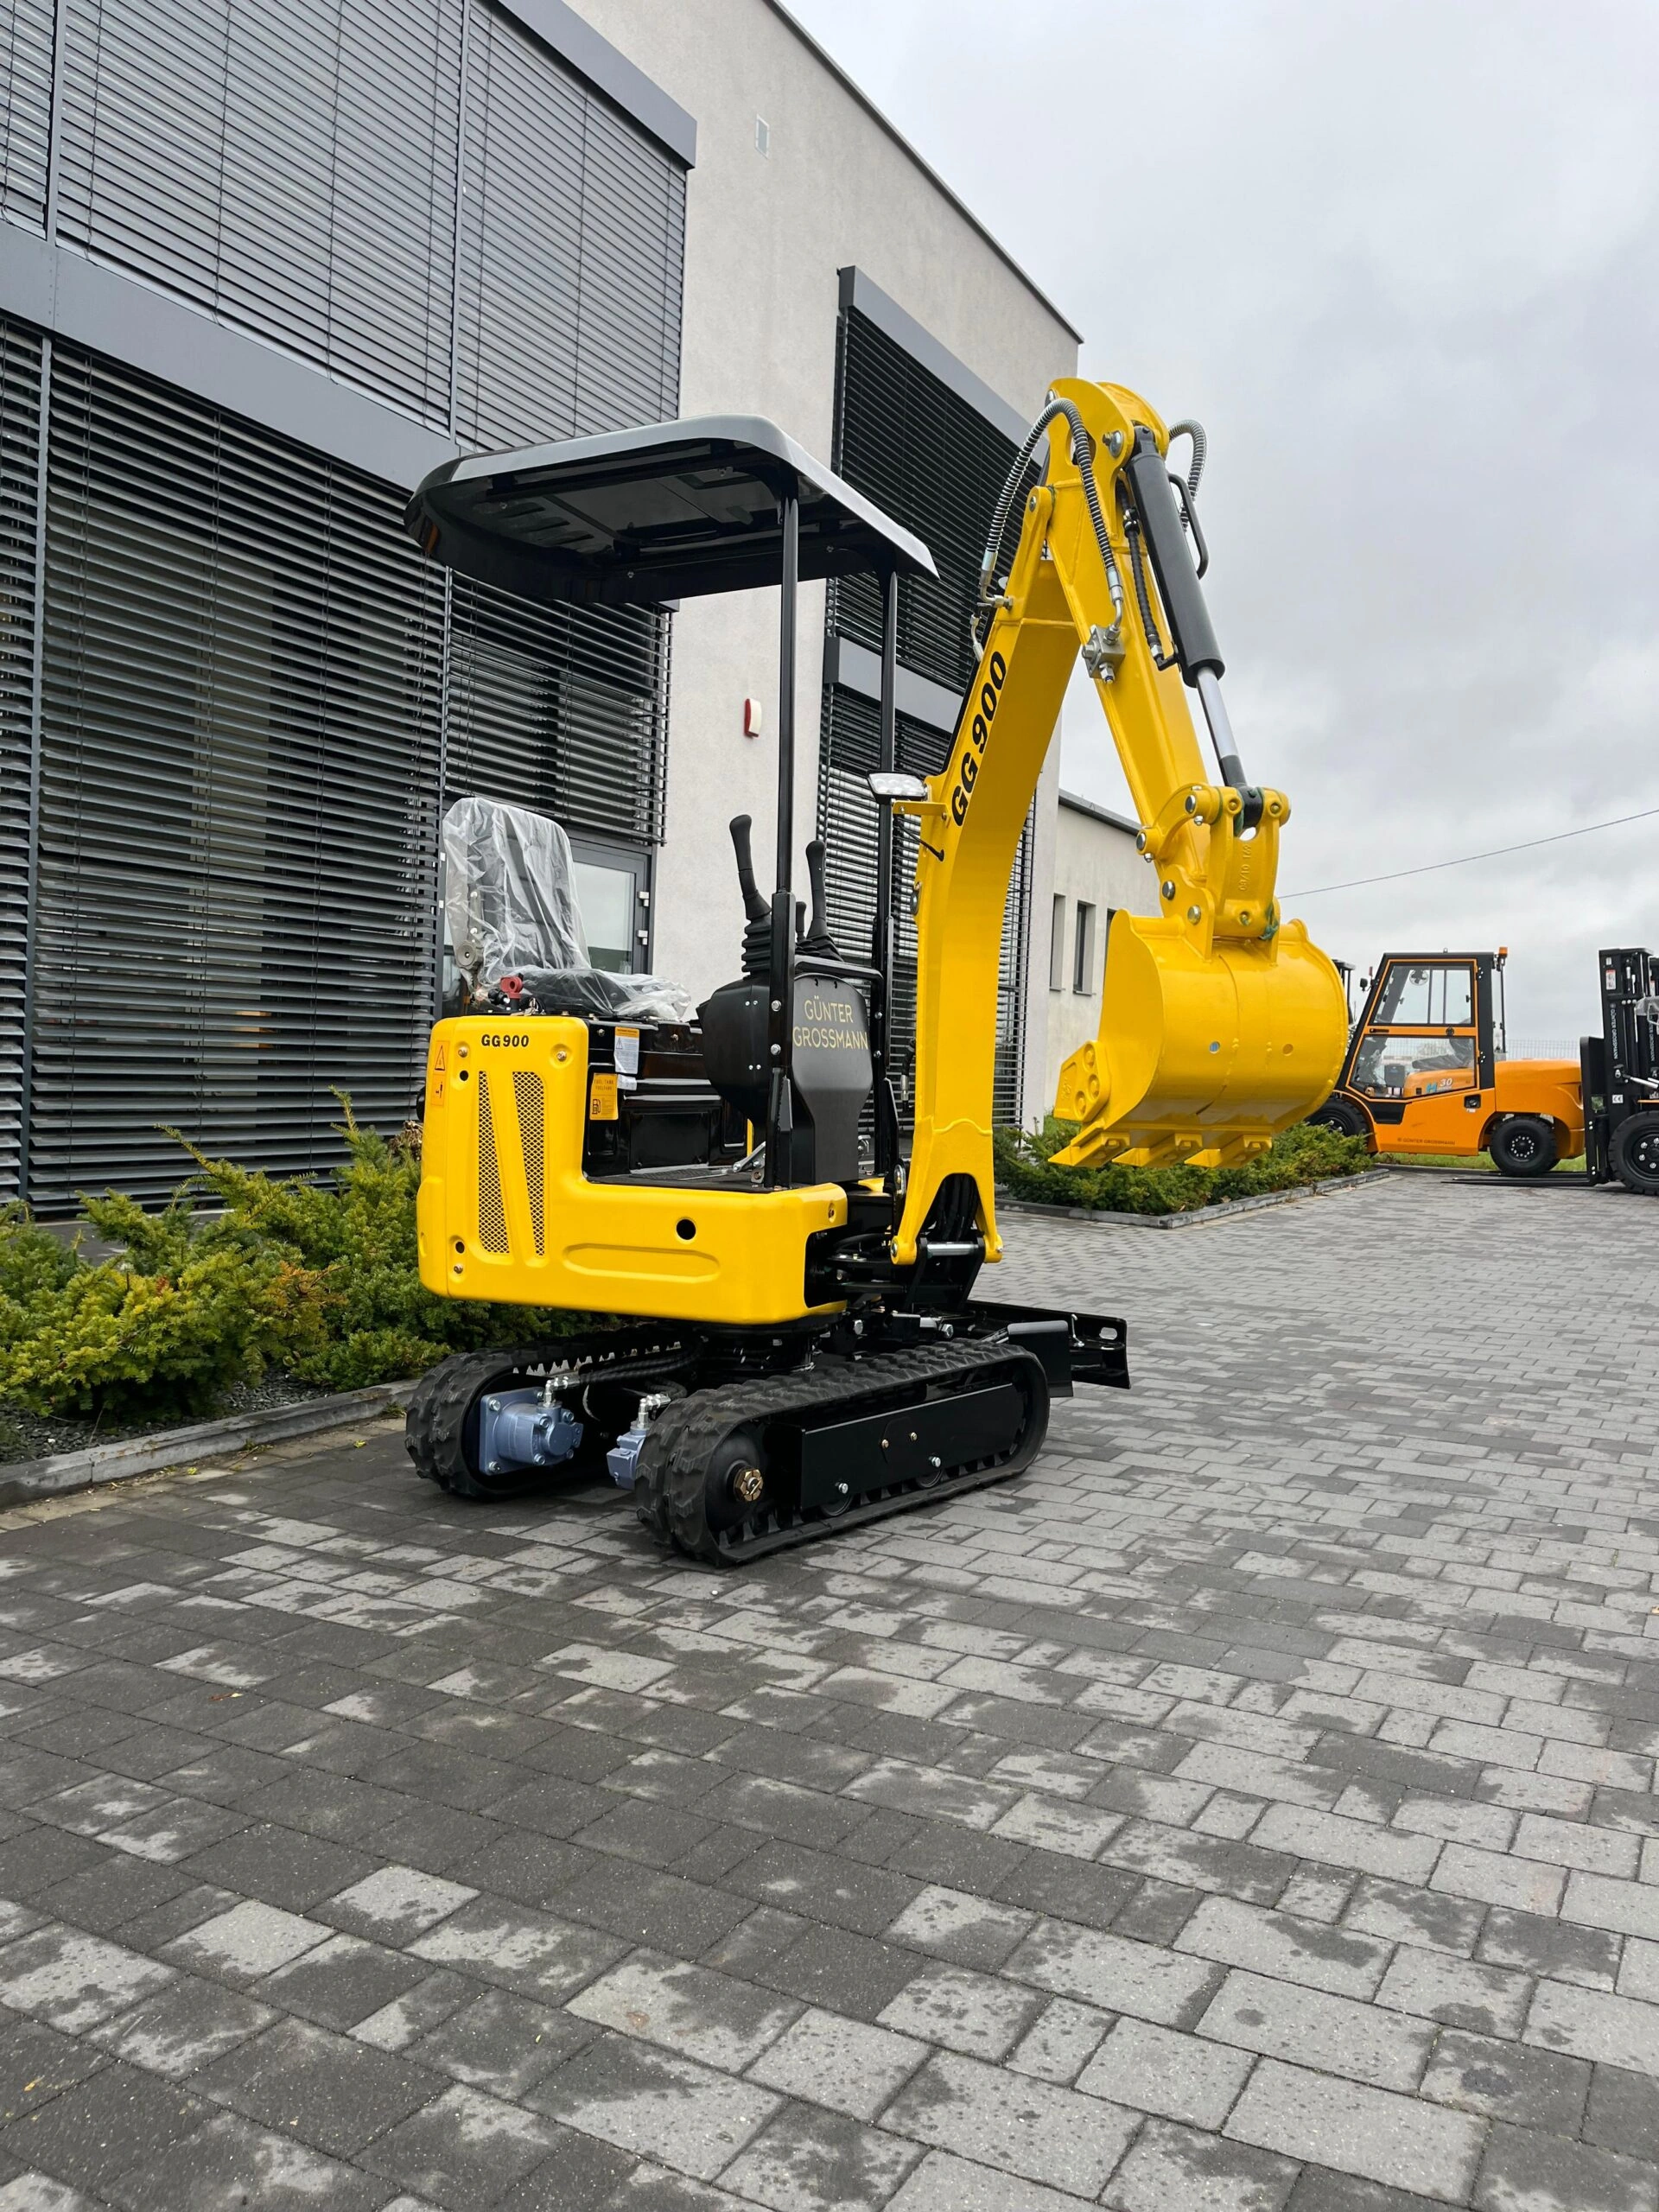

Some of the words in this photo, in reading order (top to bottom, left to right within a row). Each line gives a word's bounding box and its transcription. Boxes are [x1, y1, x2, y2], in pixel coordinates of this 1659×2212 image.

[804, 995, 854, 1023] GÜNTER
[481, 1033, 530, 1048] GG900
[792, 1027, 868, 1050] GROSSMANN
[1440, 1077, 1452, 1087] 30
